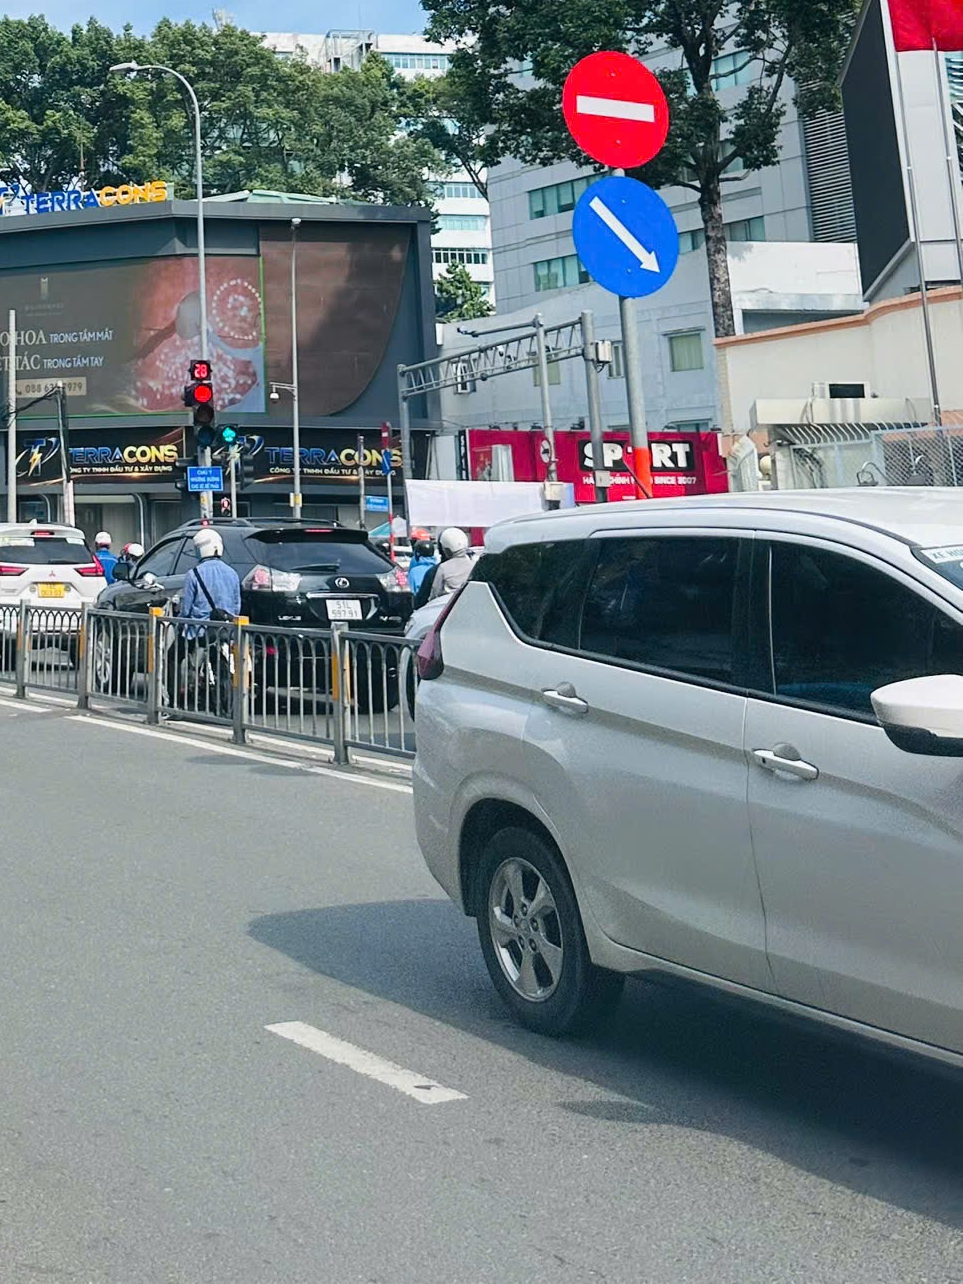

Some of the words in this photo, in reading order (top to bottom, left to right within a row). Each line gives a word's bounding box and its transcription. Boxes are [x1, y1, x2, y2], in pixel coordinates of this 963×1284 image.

[21, 180, 168, 215] TERRACONS
[14, 329, 47, 346] HOA
[49, 333, 78, 343] TRONG
[15, 351, 41, 371] TÁC
[43, 358, 72, 369] TRONG
[90, 356, 104, 367] TAY
[194, 364, 208, 378] 28
[583, 442, 690, 468] SPRT
[654, 476, 677, 485] SINCE
[336, 600, 351, 609] 51L
